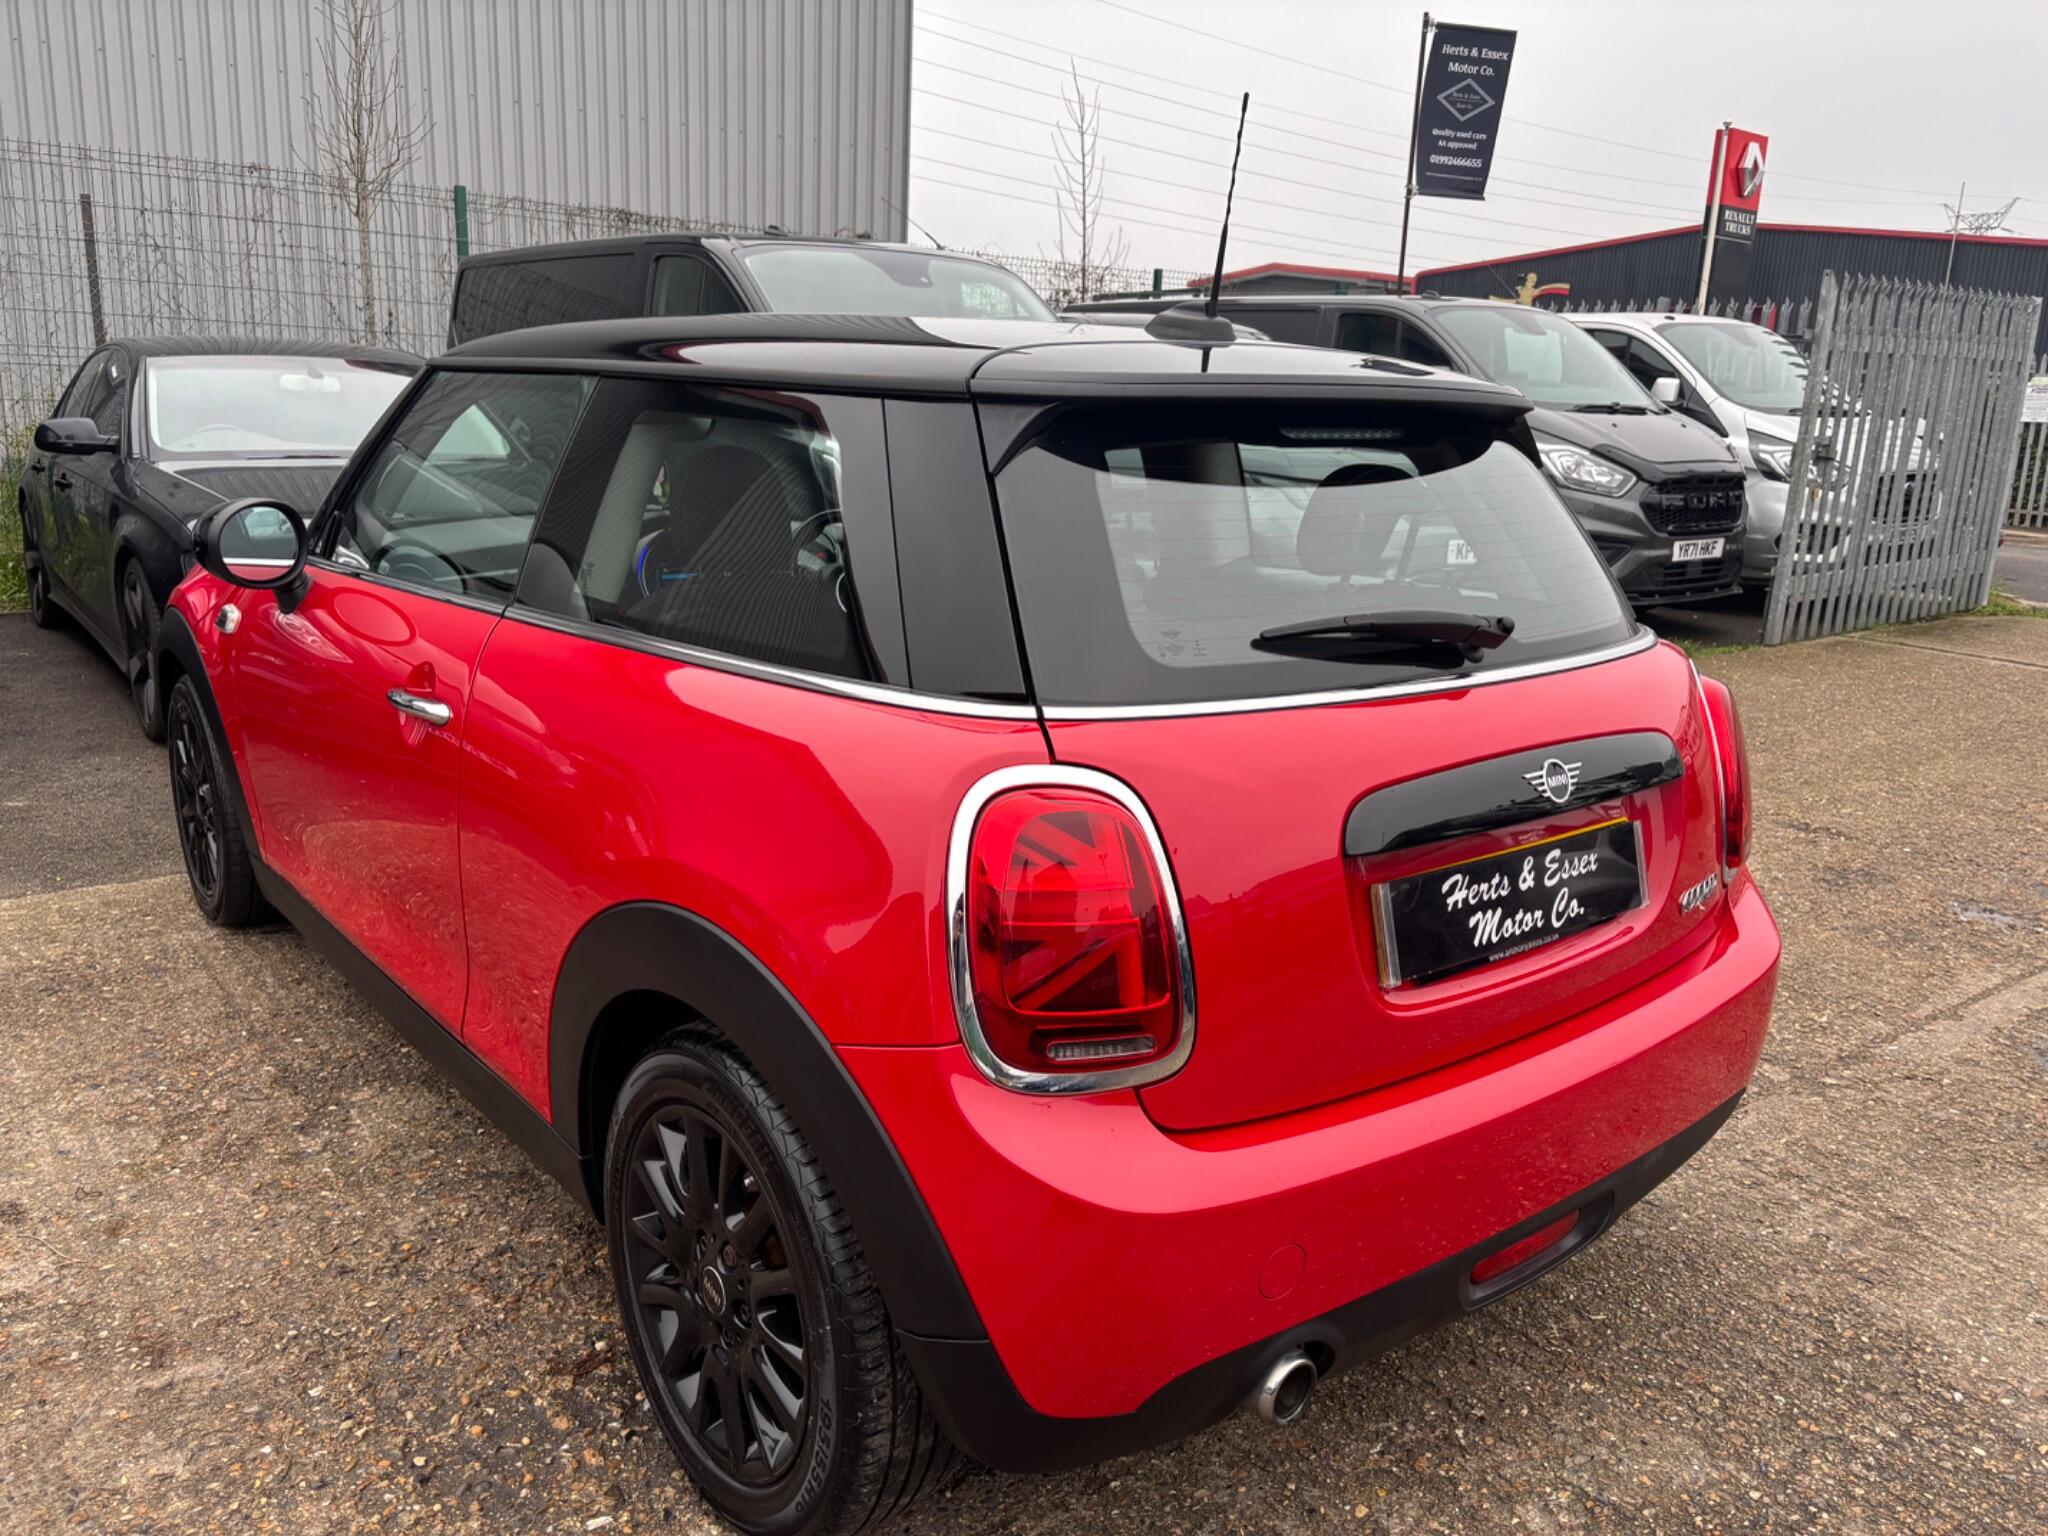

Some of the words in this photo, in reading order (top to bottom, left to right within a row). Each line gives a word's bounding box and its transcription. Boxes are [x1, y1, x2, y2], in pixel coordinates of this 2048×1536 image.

[1442, 44, 1470, 57] Herts
[1470, 47, 1479, 58] &
[1481, 48, 1510, 61] Essex
[1448, 61, 1480, 75] Motor
[1432, 128, 1456, 139] Quality
[1725, 209, 1756, 225] RENAULT
[1725, 221, 1752, 236] TRUCKS
[1547, 773, 1569, 788] MINI
[1441, 872, 1512, 912] Herts
[1518, 856, 1536, 891] &
[1544, 848, 1599, 887] Essex
[1469, 906, 1545, 947] Motor
[1551, 887, 1585, 928] Co.
